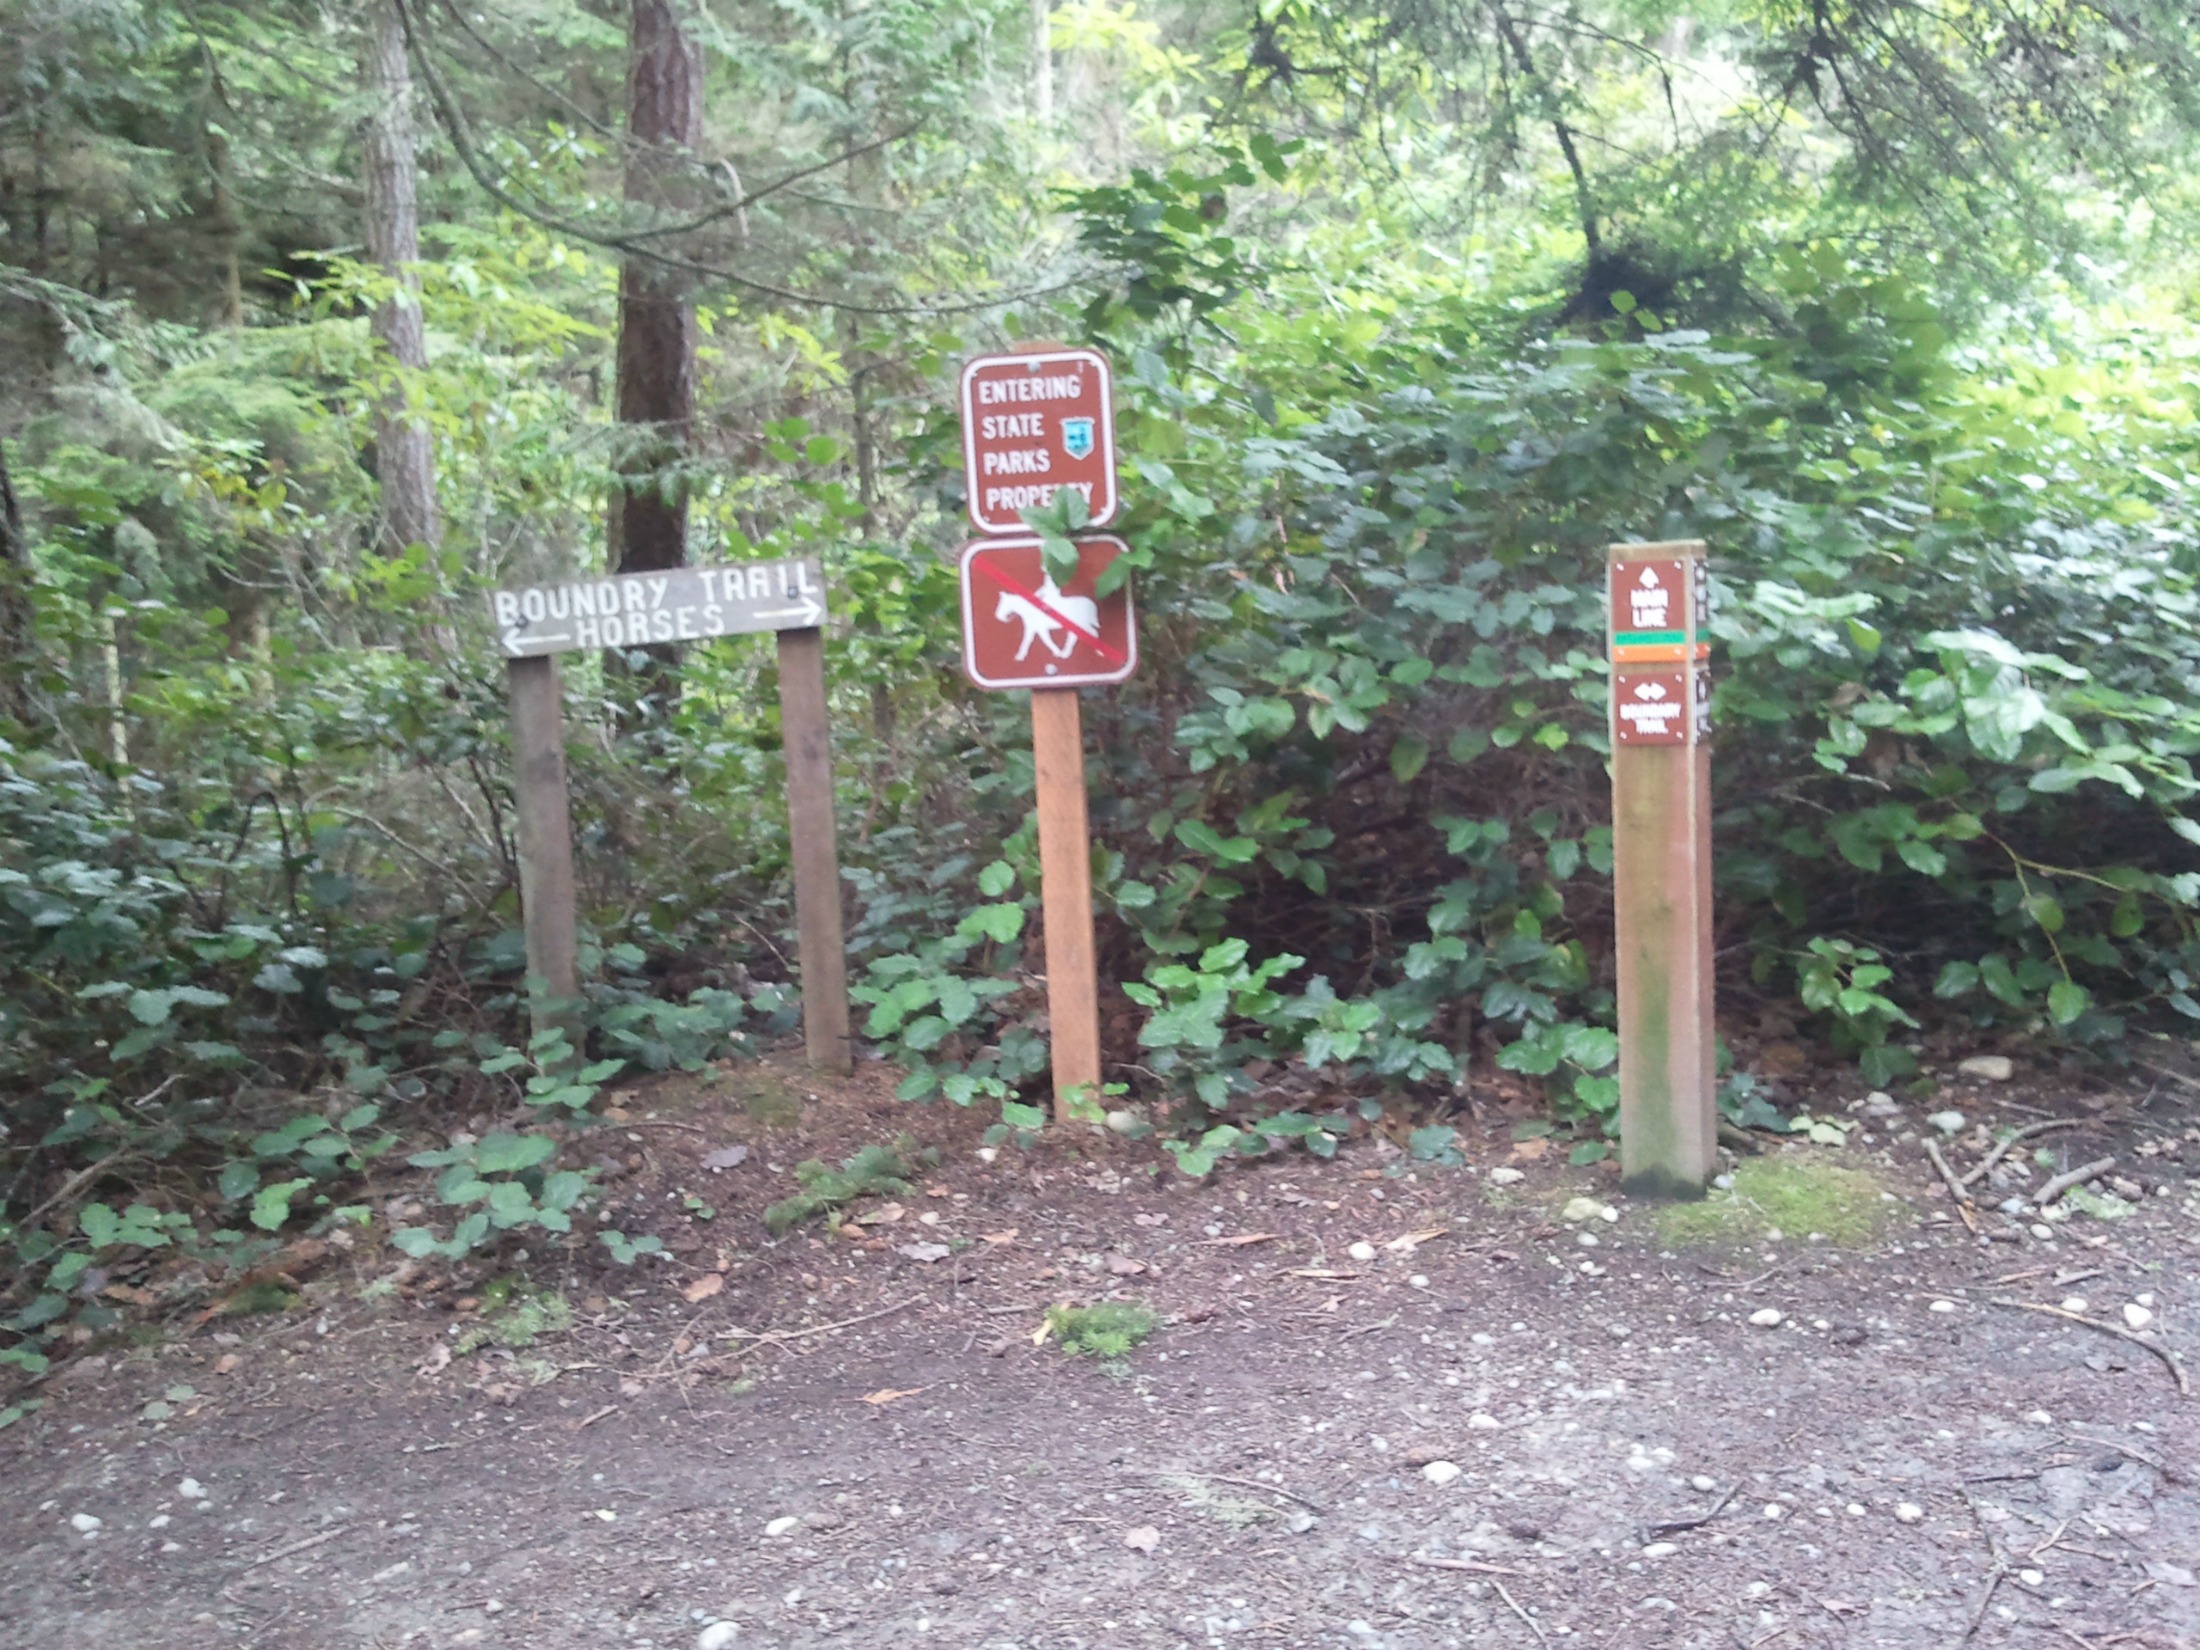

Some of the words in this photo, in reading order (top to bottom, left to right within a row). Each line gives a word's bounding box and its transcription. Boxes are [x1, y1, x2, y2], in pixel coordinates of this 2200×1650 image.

[978, 374, 1082, 405] ENTERING
[981, 413, 1045, 440] STATE
[983, 449, 1051, 476] PARKS
[985, 481, 1094, 511] PROPEY
[494, 576, 669, 628] BOUNDRY
[697, 561, 819, 603] TRAIL
[575, 604, 726, 648] HORSES
